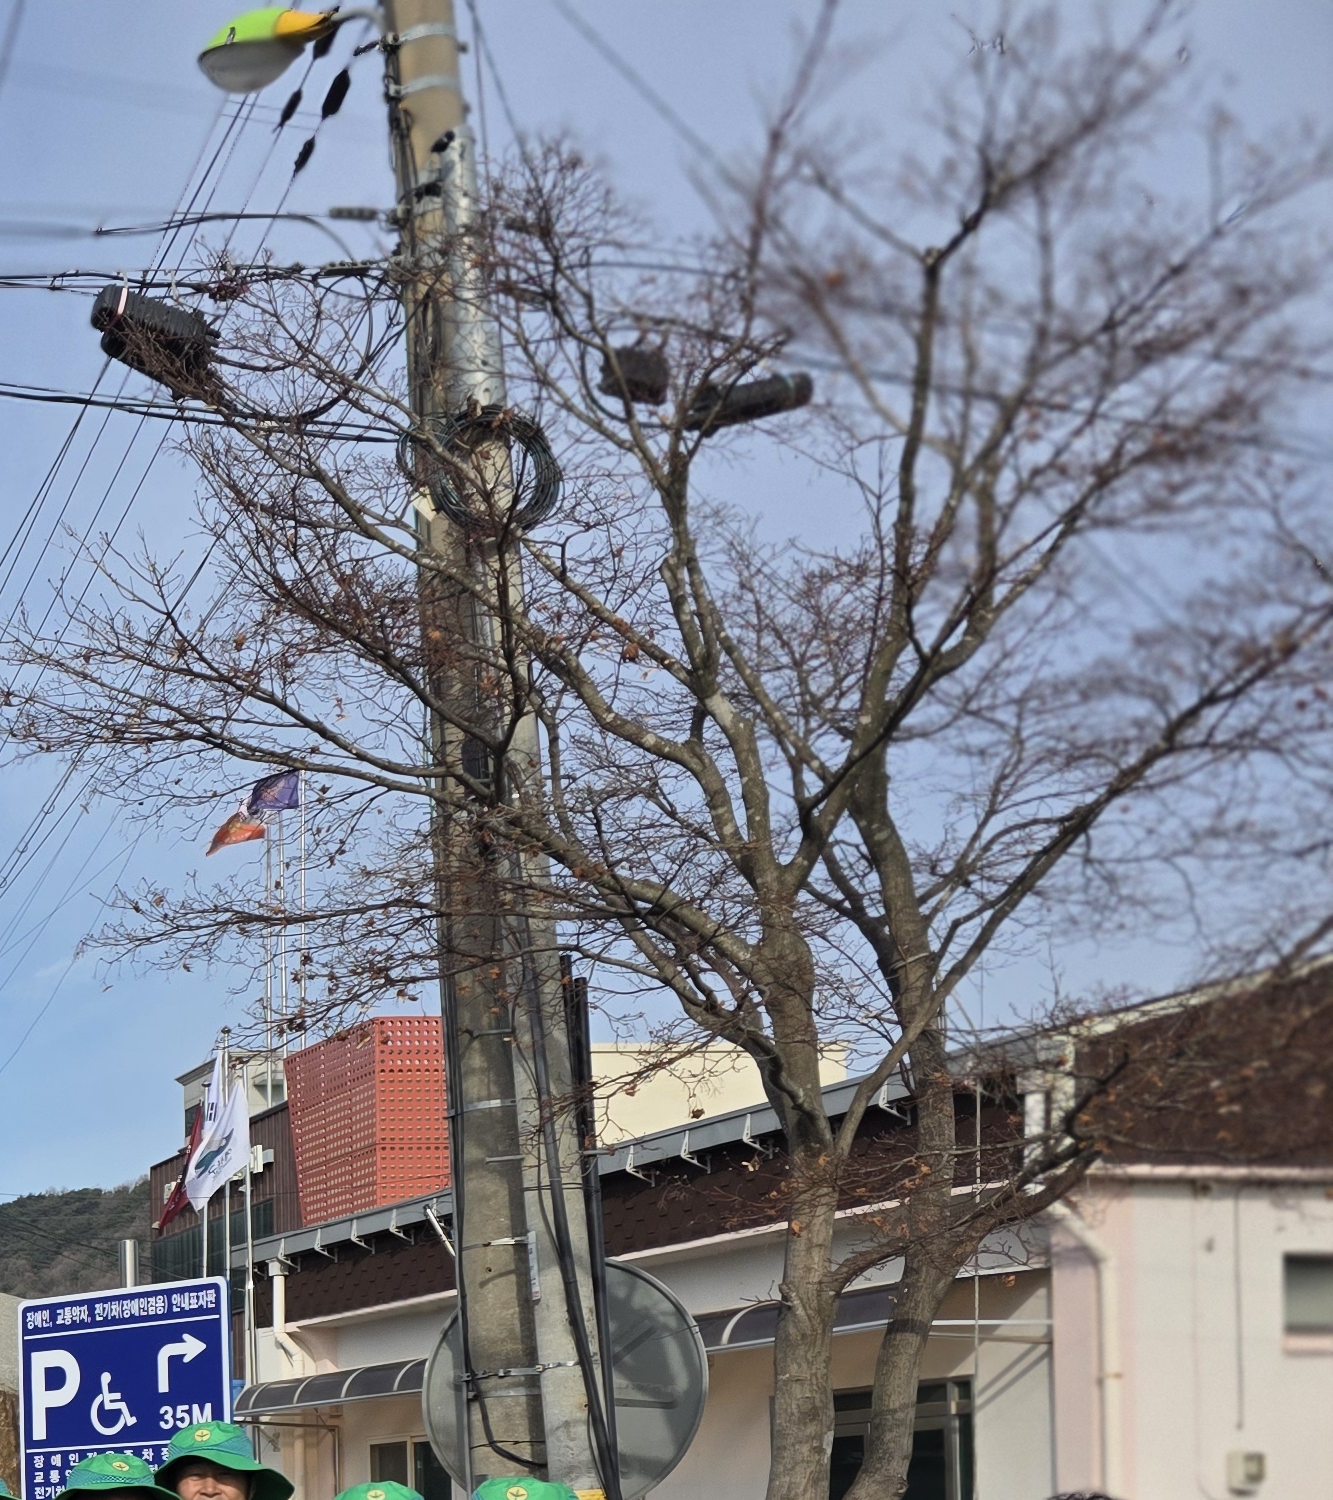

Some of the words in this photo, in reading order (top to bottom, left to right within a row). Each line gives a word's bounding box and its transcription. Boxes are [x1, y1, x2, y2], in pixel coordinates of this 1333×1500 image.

[26, 1311, 52, 1329] 장애인,
[56, 1306, 91, 1325] 교통약자,
[94, 1295, 169, 1322] 전기차(장애인겸용)
[171, 1289, 216, 1312] 안내표지판
[30, 1350, 81, 1441] P
[159, 1403, 213, 1430] 35M
